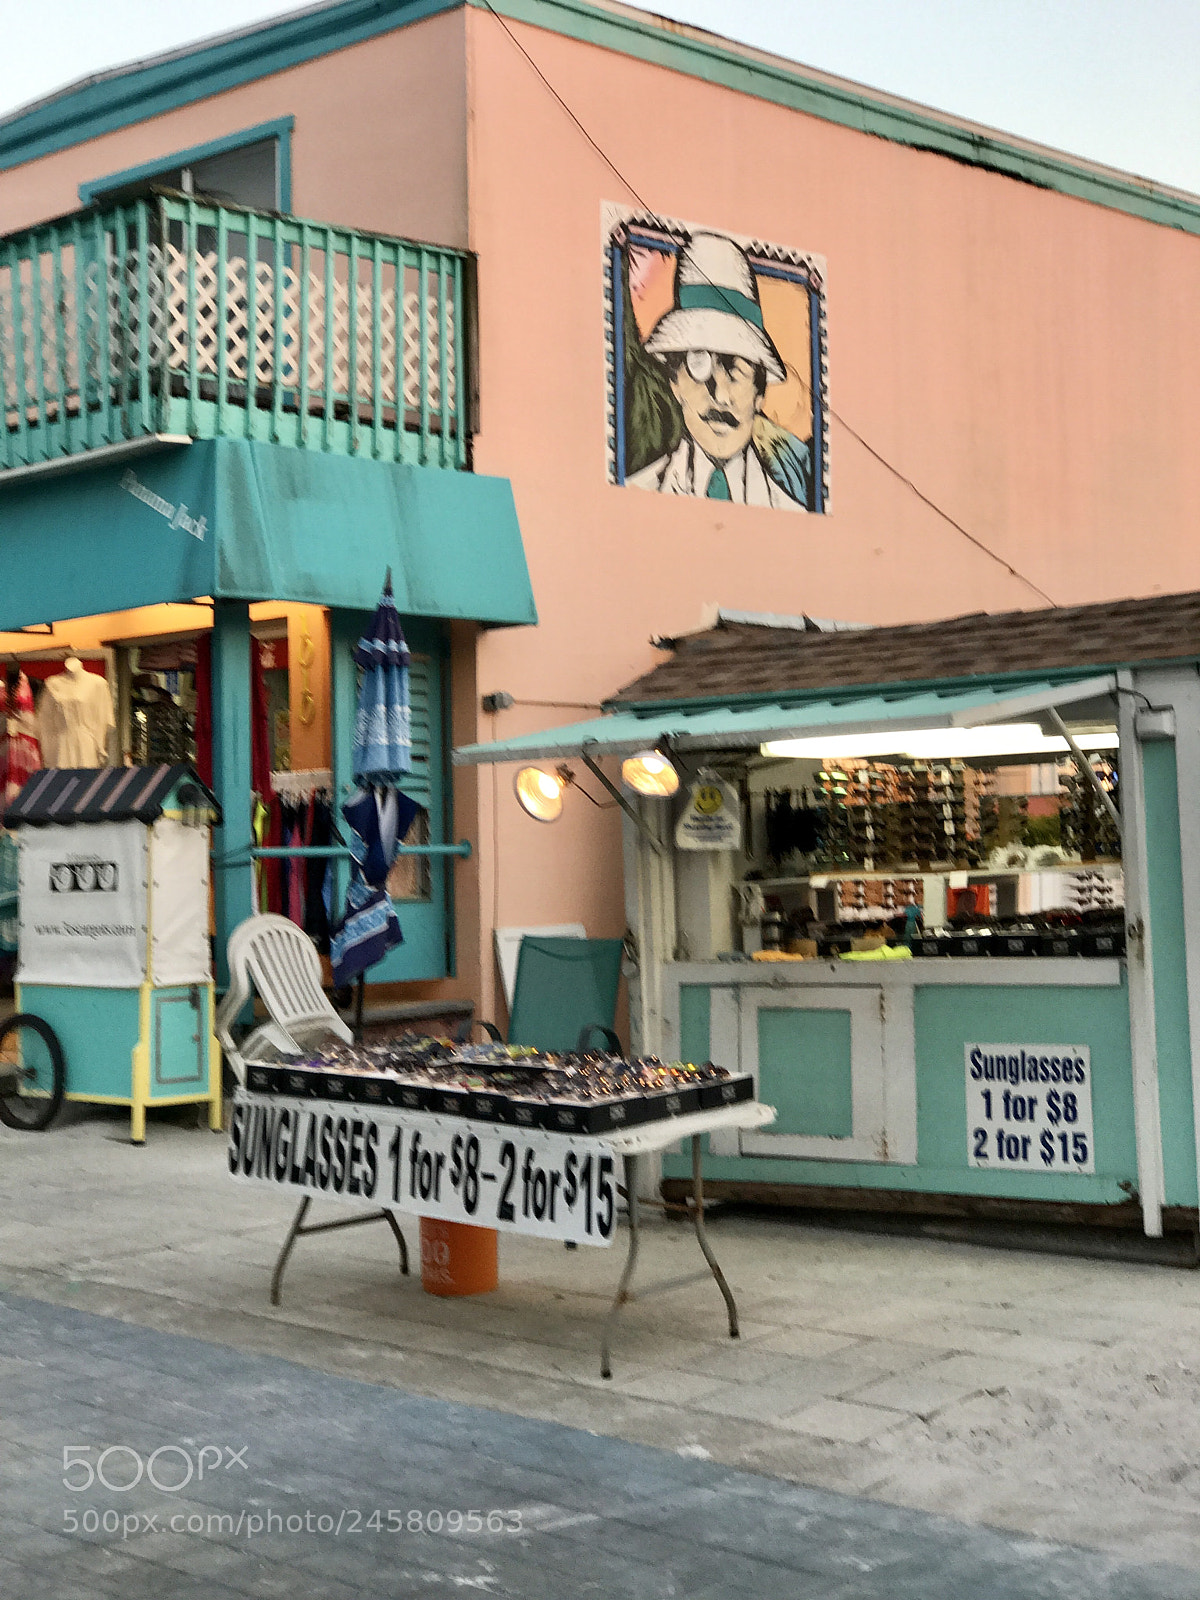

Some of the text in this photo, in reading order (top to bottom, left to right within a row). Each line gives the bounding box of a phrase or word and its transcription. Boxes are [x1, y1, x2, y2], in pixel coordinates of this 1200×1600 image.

[970, 1047, 1085, 1086] Sunglasses
[980, 1087, 1078, 1127] 1 for $8
[973, 1126, 1088, 1167] 2 for $15
[228, 1104, 379, 1200] SUNGLASSES
[388, 1124, 402, 1203] 1
[409, 1129, 446, 1202] for
[522, 1146, 561, 1223] for
[563, 1149, 614, 1239] $15
